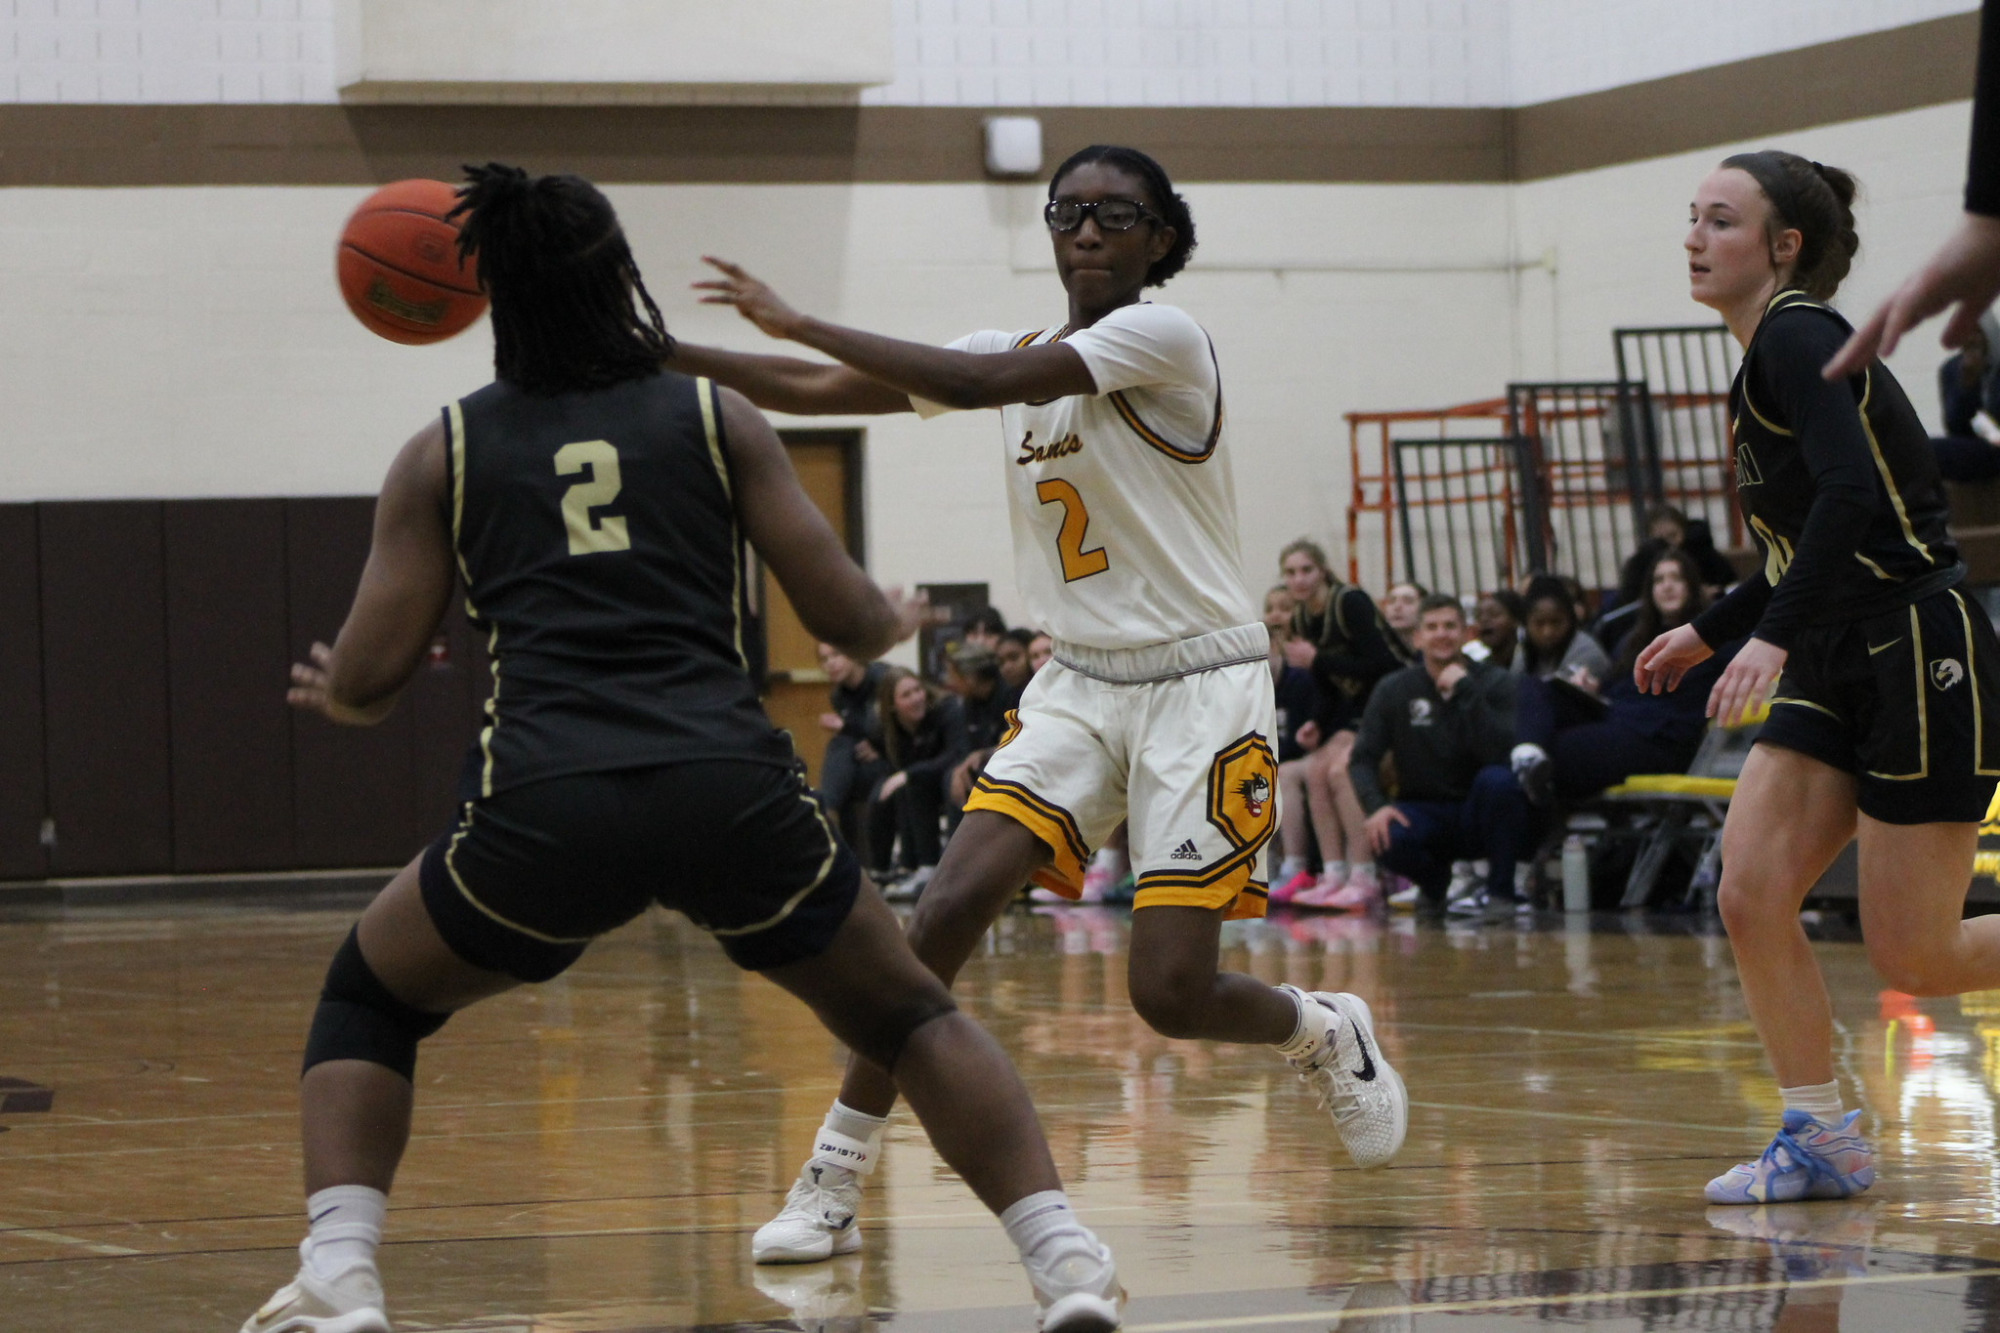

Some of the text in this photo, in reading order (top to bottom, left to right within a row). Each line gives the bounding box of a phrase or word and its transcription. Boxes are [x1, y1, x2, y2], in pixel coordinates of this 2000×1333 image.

[1016, 430, 1083, 466] Saints
[553, 439, 631, 556] 2
[1036, 477, 1109, 583] 2
[1170, 851, 1202, 861] adidas
